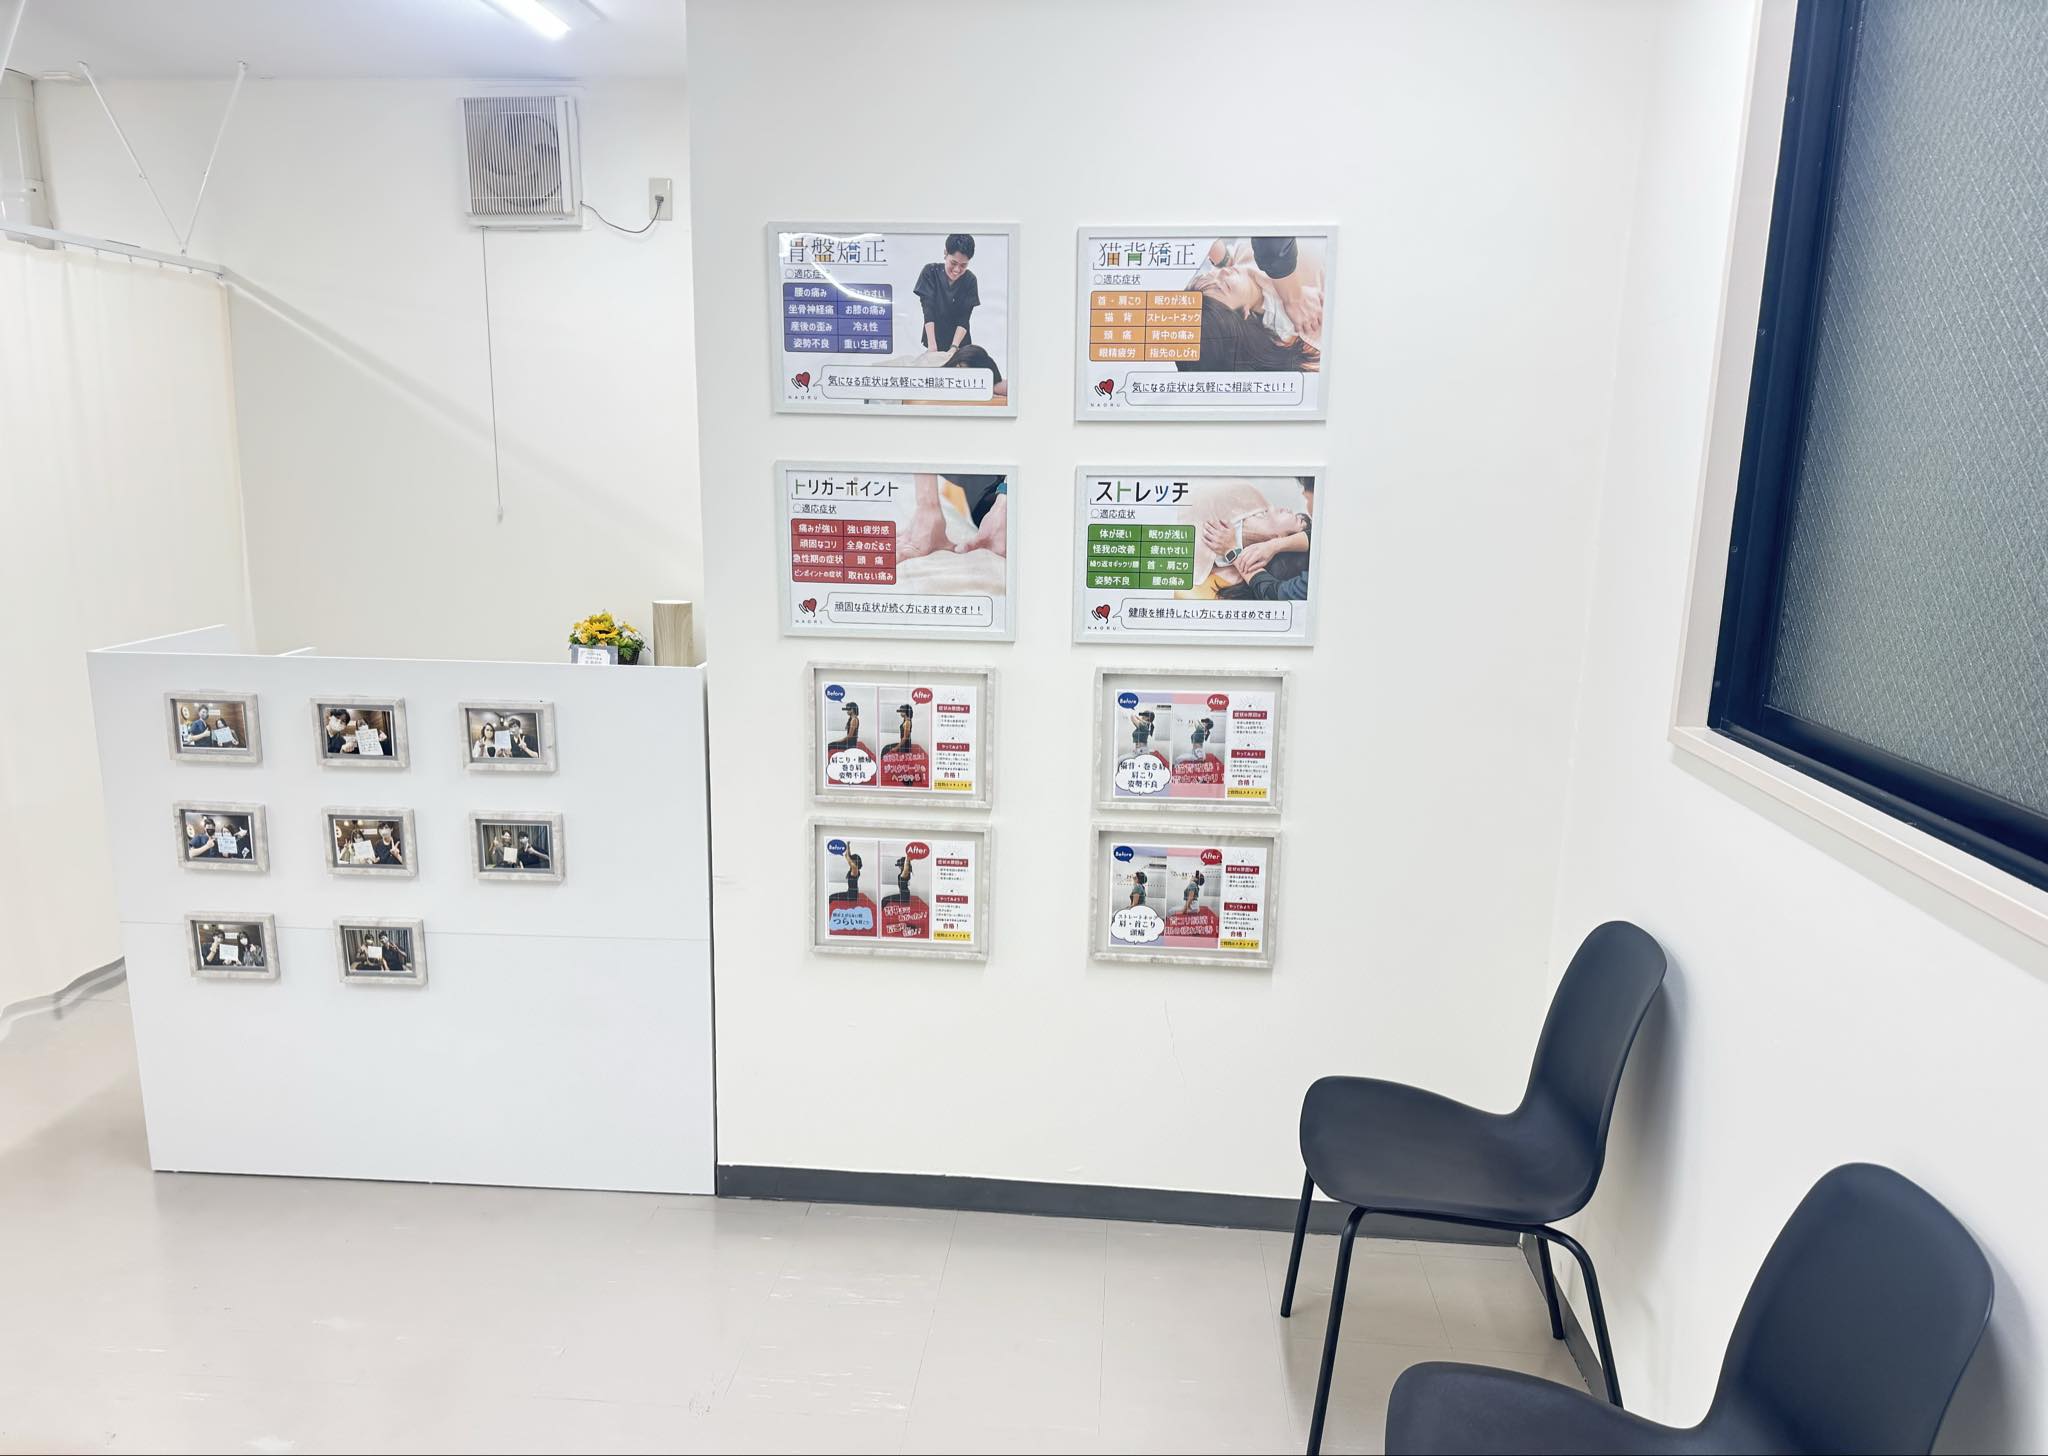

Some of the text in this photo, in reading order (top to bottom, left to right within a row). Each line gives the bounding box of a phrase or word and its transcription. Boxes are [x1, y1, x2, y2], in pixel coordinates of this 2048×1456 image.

[790, 237, 886, 263] 骨盤矯正
[1099, 242, 1196, 266] 猫背矯正
[794, 288, 828, 298] 腰の痛み
[1154, 296, 1195, 306] 眠りが浅い
[788, 305, 834, 314] 坐骨神経痛
[846, 305, 886, 315] お膝の痛み
[1147, 314, 1200, 322] ストレートネック
[790, 321, 832, 332] 産後の歪み
[853, 321, 879, 332] 冷え性
[1152, 330, 1194, 340] 背中の痛み
[793, 338, 830, 348] 姿勢不良
[844, 338, 888, 350] 重い生理痛
[1099, 348, 1136, 358] 眼精疲労
[1150, 348, 1198, 358] 指先のしびれ
[828, 375, 985, 388] 気になる症状は気軽にご相談下さい！！
[1132, 380, 1294, 393] 気になる症状は気軽にご相談下さい！！
[796, 478, 898, 497] トリガーポイント
[1096, 481, 1188, 503] ストレッチ
[798, 524, 837, 533] 痛みが強い
[847, 525, 890, 536] 強い疲労感
[1100, 529, 1132, 539] 体が硬い
[1148, 530, 1188, 540] 眠りが浅い
[800, 539, 837, 548] 頑固なコリ
[846, 541, 892, 551] 全身のだるさ
[1093, 544, 1136, 554] 怪我の改善
[1150, 546, 1188, 555] 疲れやすい
[793, 554, 844, 564] 急性期の症状
[794, 569, 842, 578] ピンポイントの症状
[848, 571, 894, 581] 取れない痛み
[1095, 576, 1130, 586] 姿勢不良
[1152, 576, 1185, 586] 腰の痛み
[834, 601, 982, 614] 頑固な症状が続く方におすすめです！！
[1128, 607, 1287, 620] 健康を維持したい方にもおすすめです！！
[1208, 698, 1226, 706] After
[842, 764, 862, 772] 巻き肩
[1128, 780, 1158, 788] 姿勢不良
[908, 846, 926, 854] After
